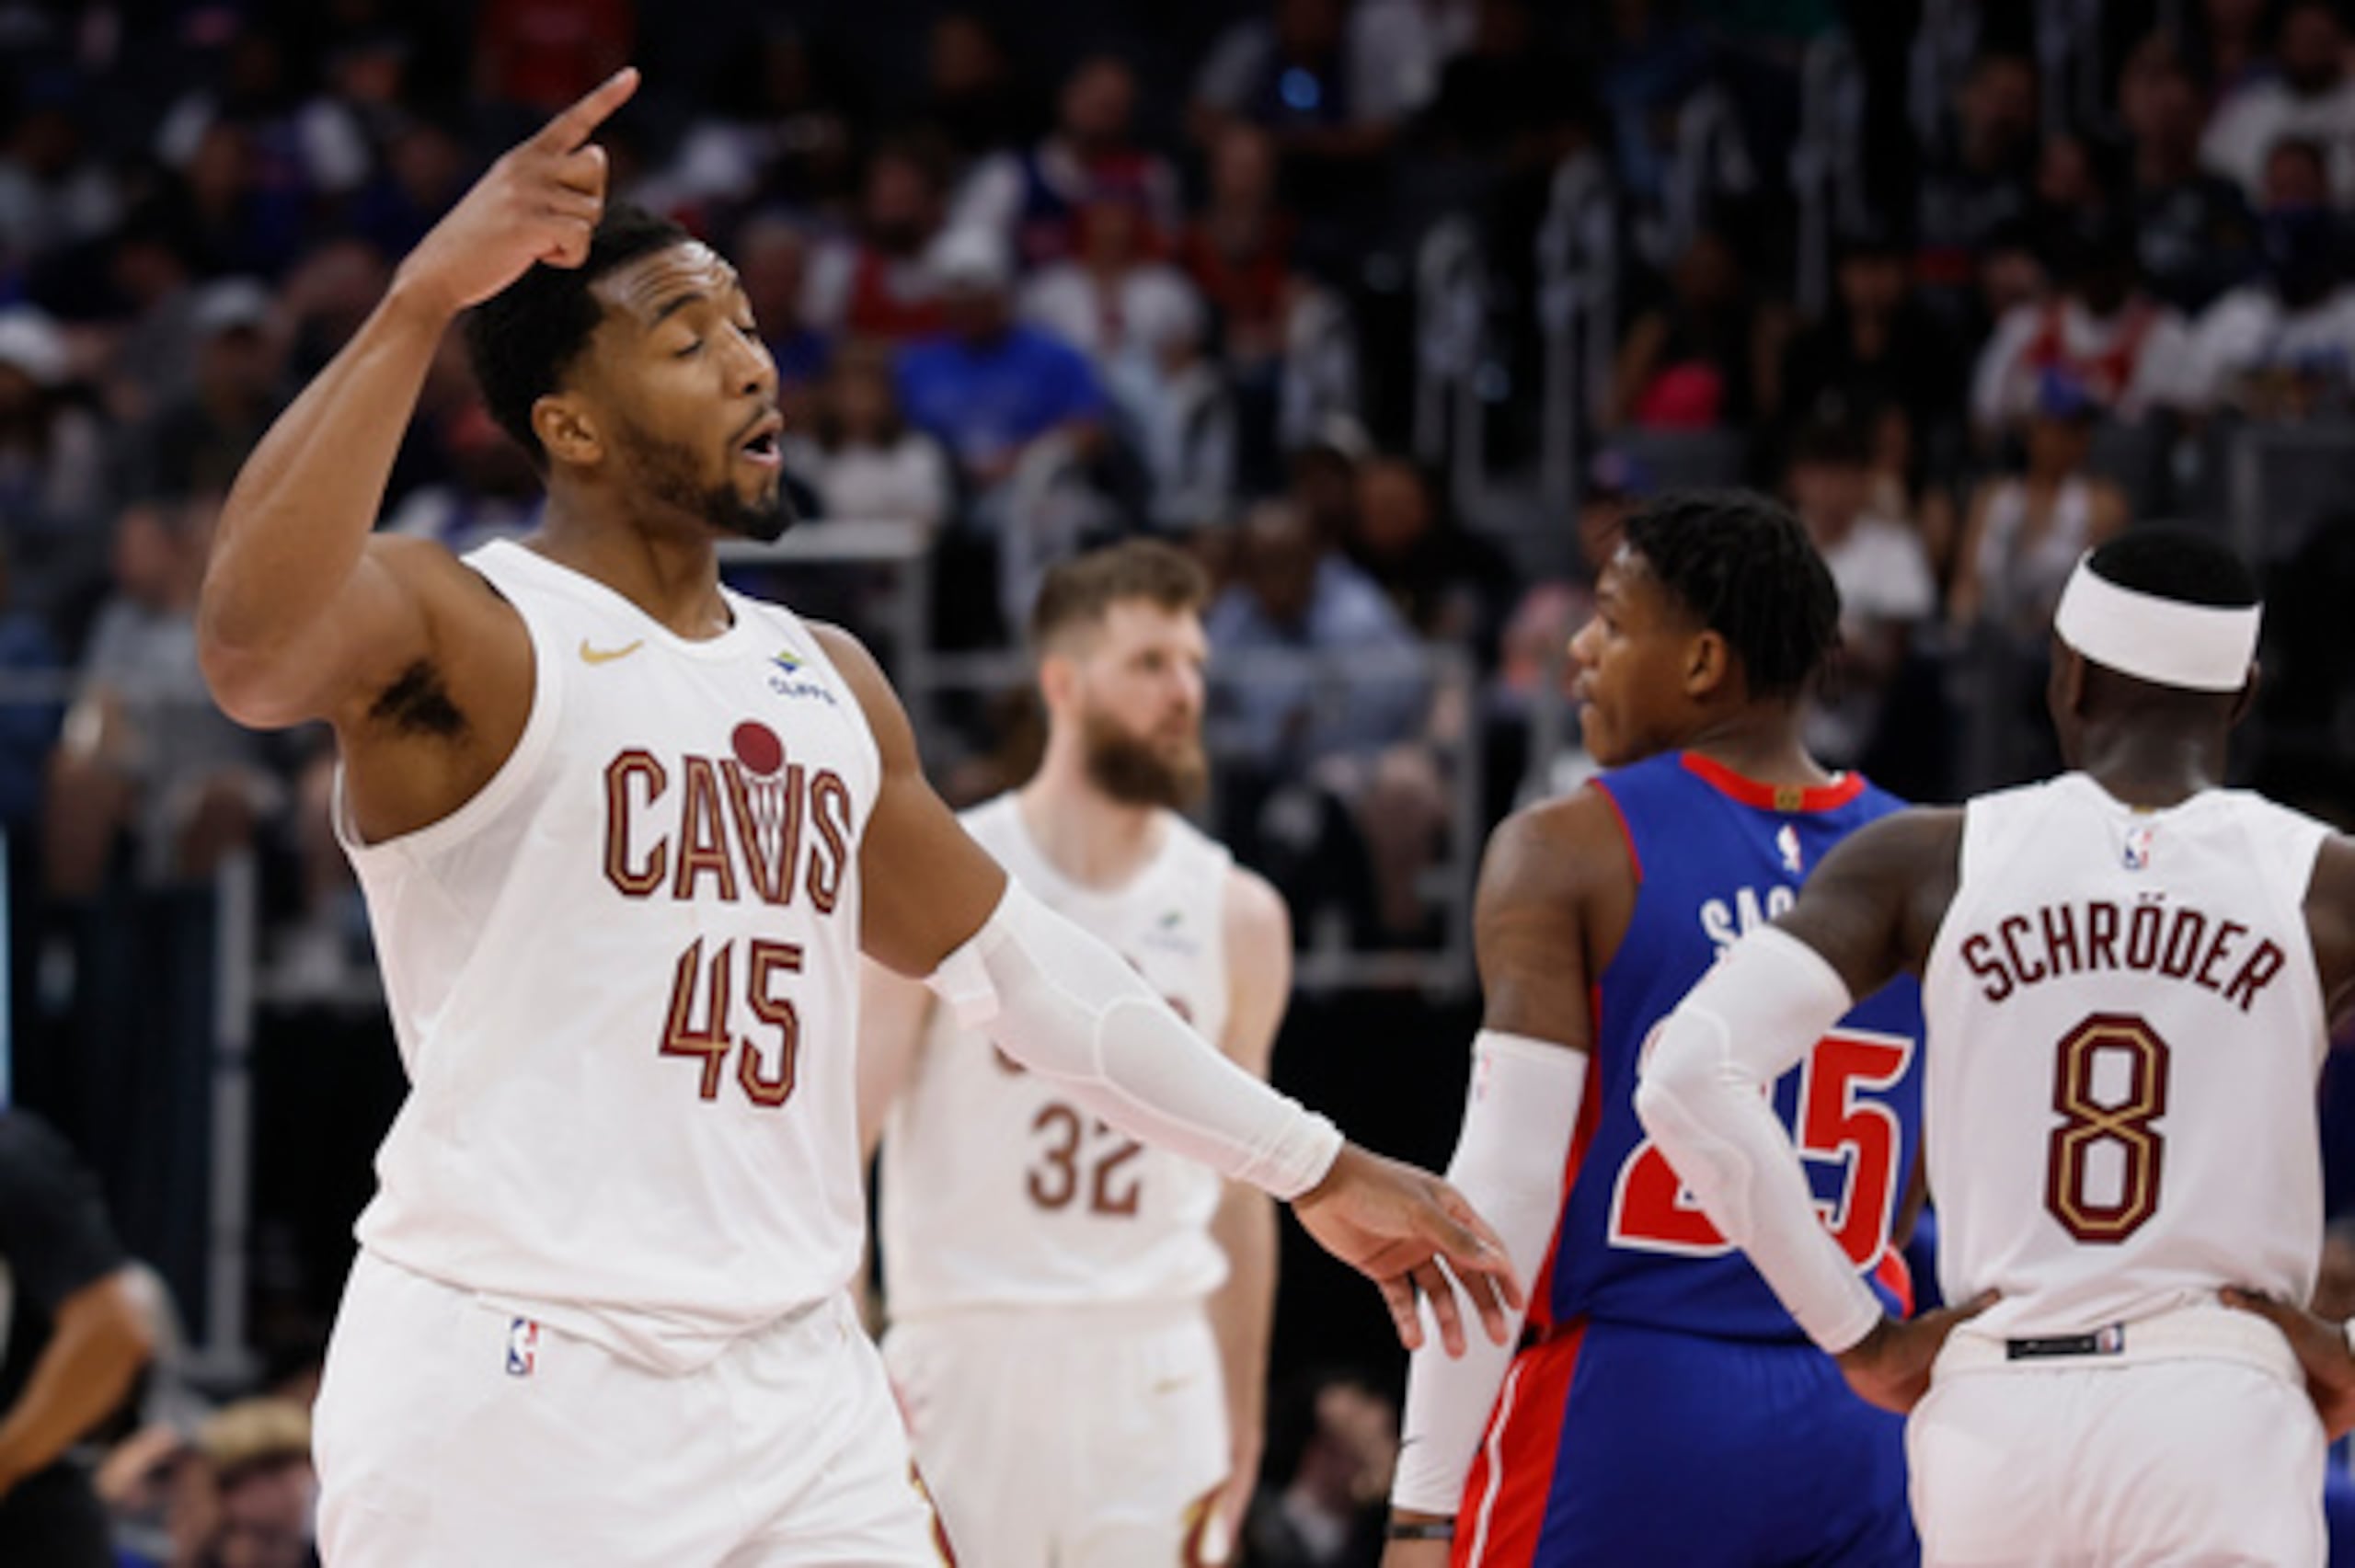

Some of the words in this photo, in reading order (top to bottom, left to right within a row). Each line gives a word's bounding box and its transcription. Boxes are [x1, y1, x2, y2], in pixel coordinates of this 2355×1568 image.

[603, 749, 851, 914] CAVS
[659, 936, 802, 1107] 45
[1960, 892, 2285, 1013] SCHRÖDER
[1028, 1104, 1142, 1218] 32
[2044, 1013, 2170, 1244] 8
